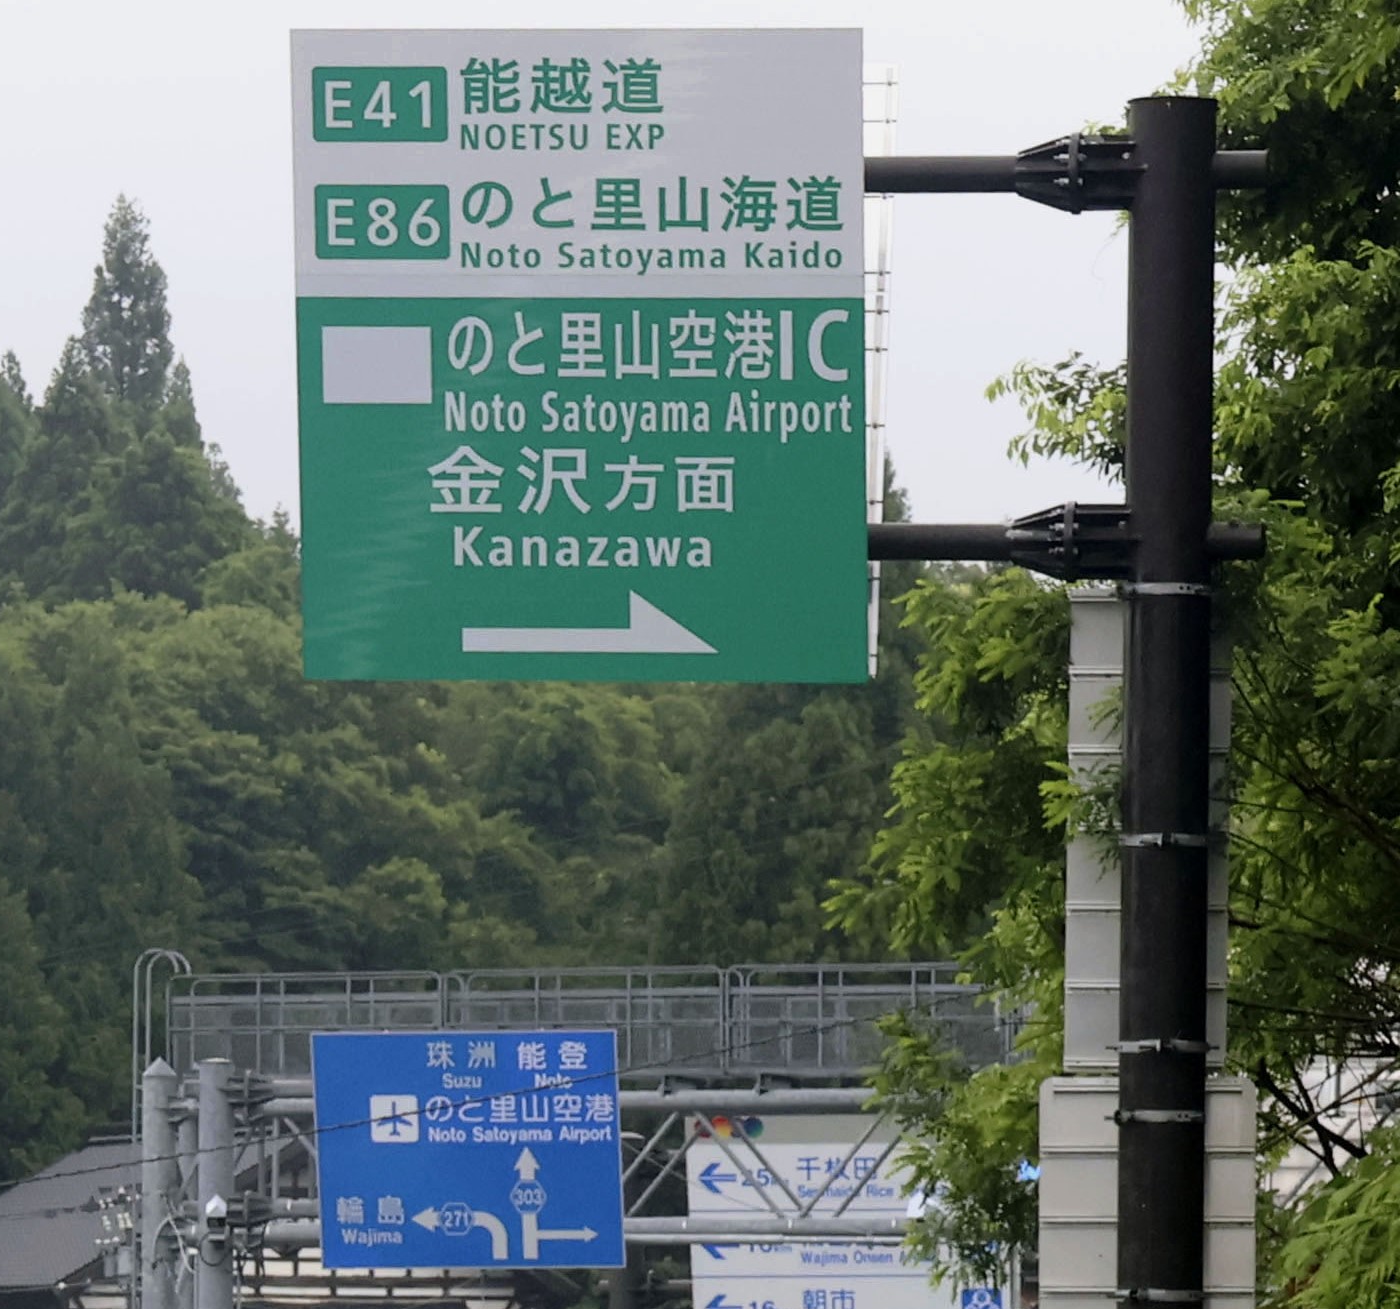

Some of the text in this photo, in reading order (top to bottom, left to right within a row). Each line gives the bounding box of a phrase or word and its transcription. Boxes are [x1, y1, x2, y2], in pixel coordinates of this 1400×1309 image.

[324, 80, 432, 129] E41
[460, 57, 664, 115] 能越道
[460, 123, 665, 150] NOETSU EXP
[326, 198, 441, 247] E86
[462, 176, 844, 233] のと里山海道
[461, 241, 843, 275] Noto Satoyama Kaido
[445, 390, 852, 442] Noto Satoyama Airport
[427, 445, 735, 515] 金沢方面
[453, 526, 713, 567] Kanazawa
[427, 1041, 587, 1070] 珠洲 能登
[442, 1073, 482, 1089] Suzu
[425, 1094, 614, 1123] のと里山空港
[428, 1126, 612, 1145] Noto Satoyama Airport
[342, 1229, 403, 1247] Wajima
